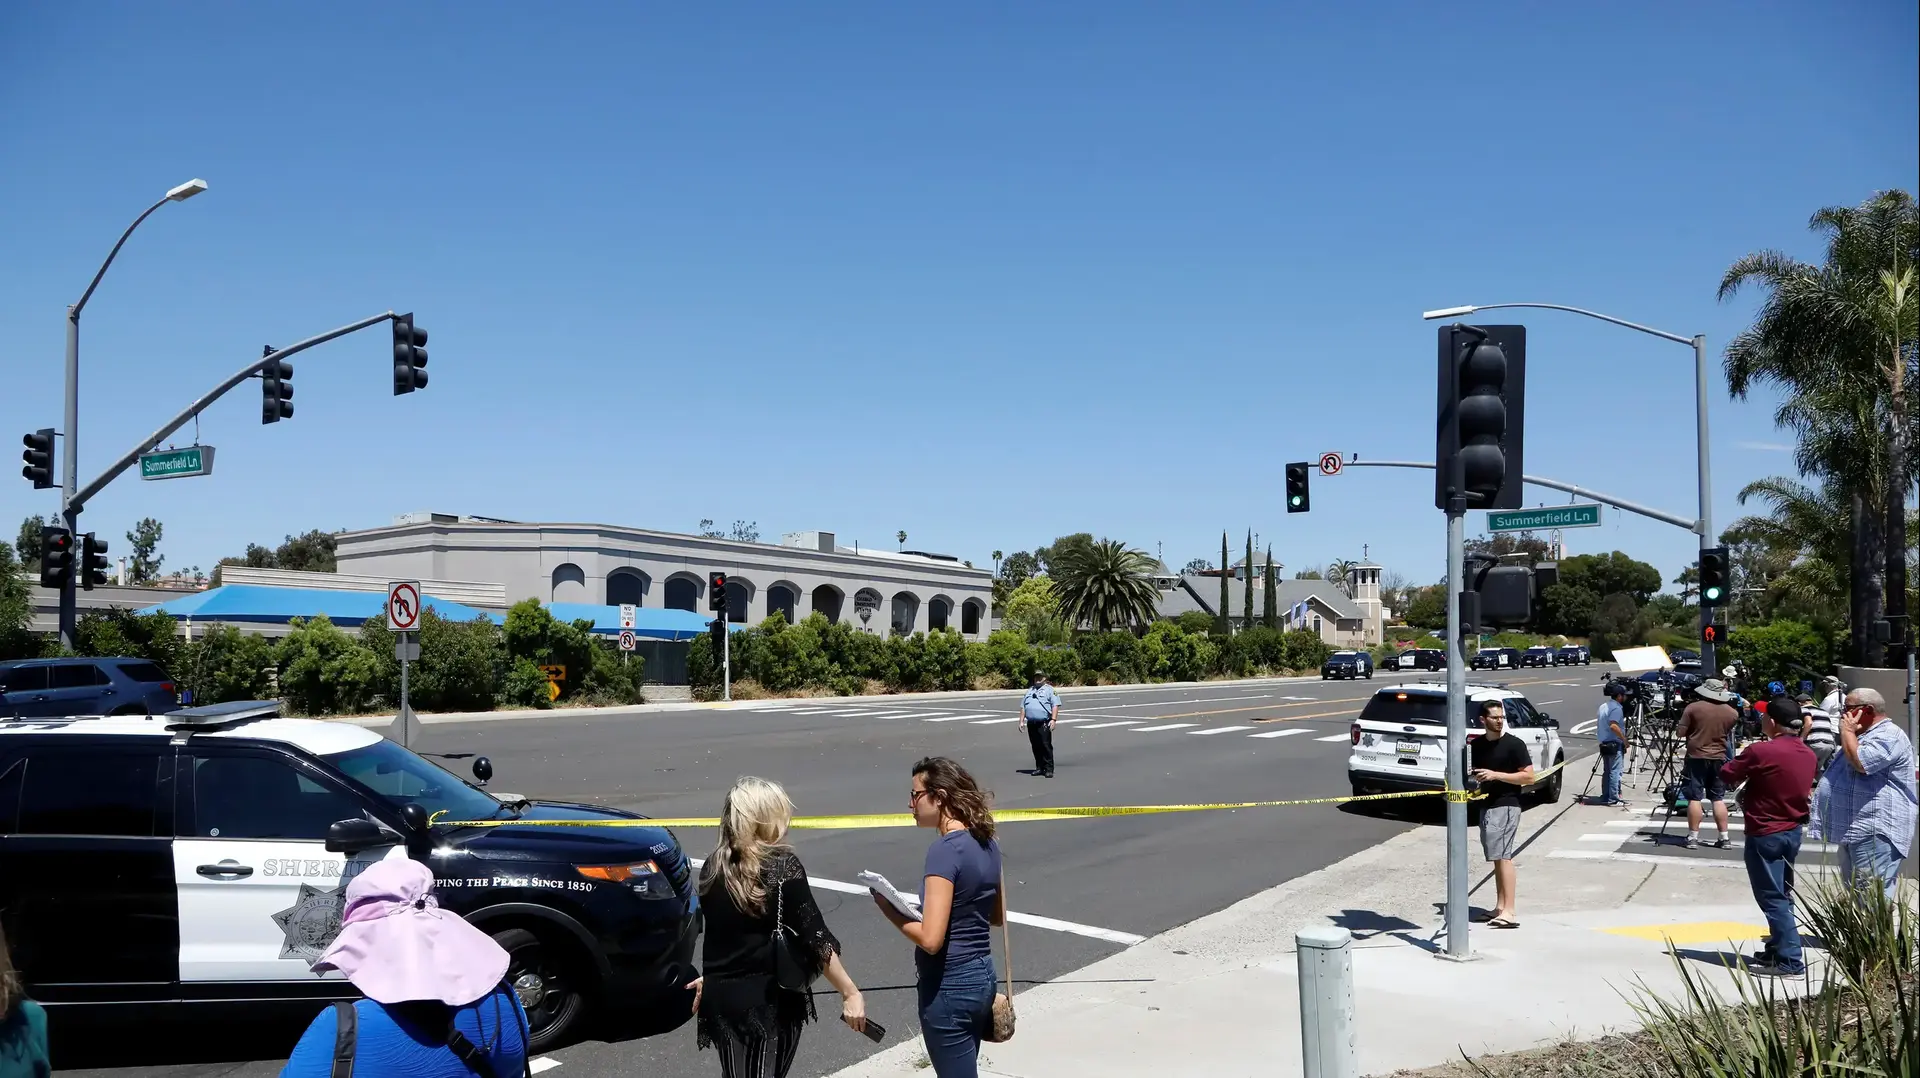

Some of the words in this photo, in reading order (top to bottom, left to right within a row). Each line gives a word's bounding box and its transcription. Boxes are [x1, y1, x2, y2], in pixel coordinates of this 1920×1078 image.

[145, 456, 187, 472] Summerfield
[187, 455, 198, 468] Ln
[1496, 512, 1571, 527] Summerfield
[1574, 511, 1590, 521] Ln
[466, 878, 489, 887] THE
[492, 876, 529, 888] PEACE
[531, 877, 564, 889] SINCE
[567, 880, 593, 892] 1850
